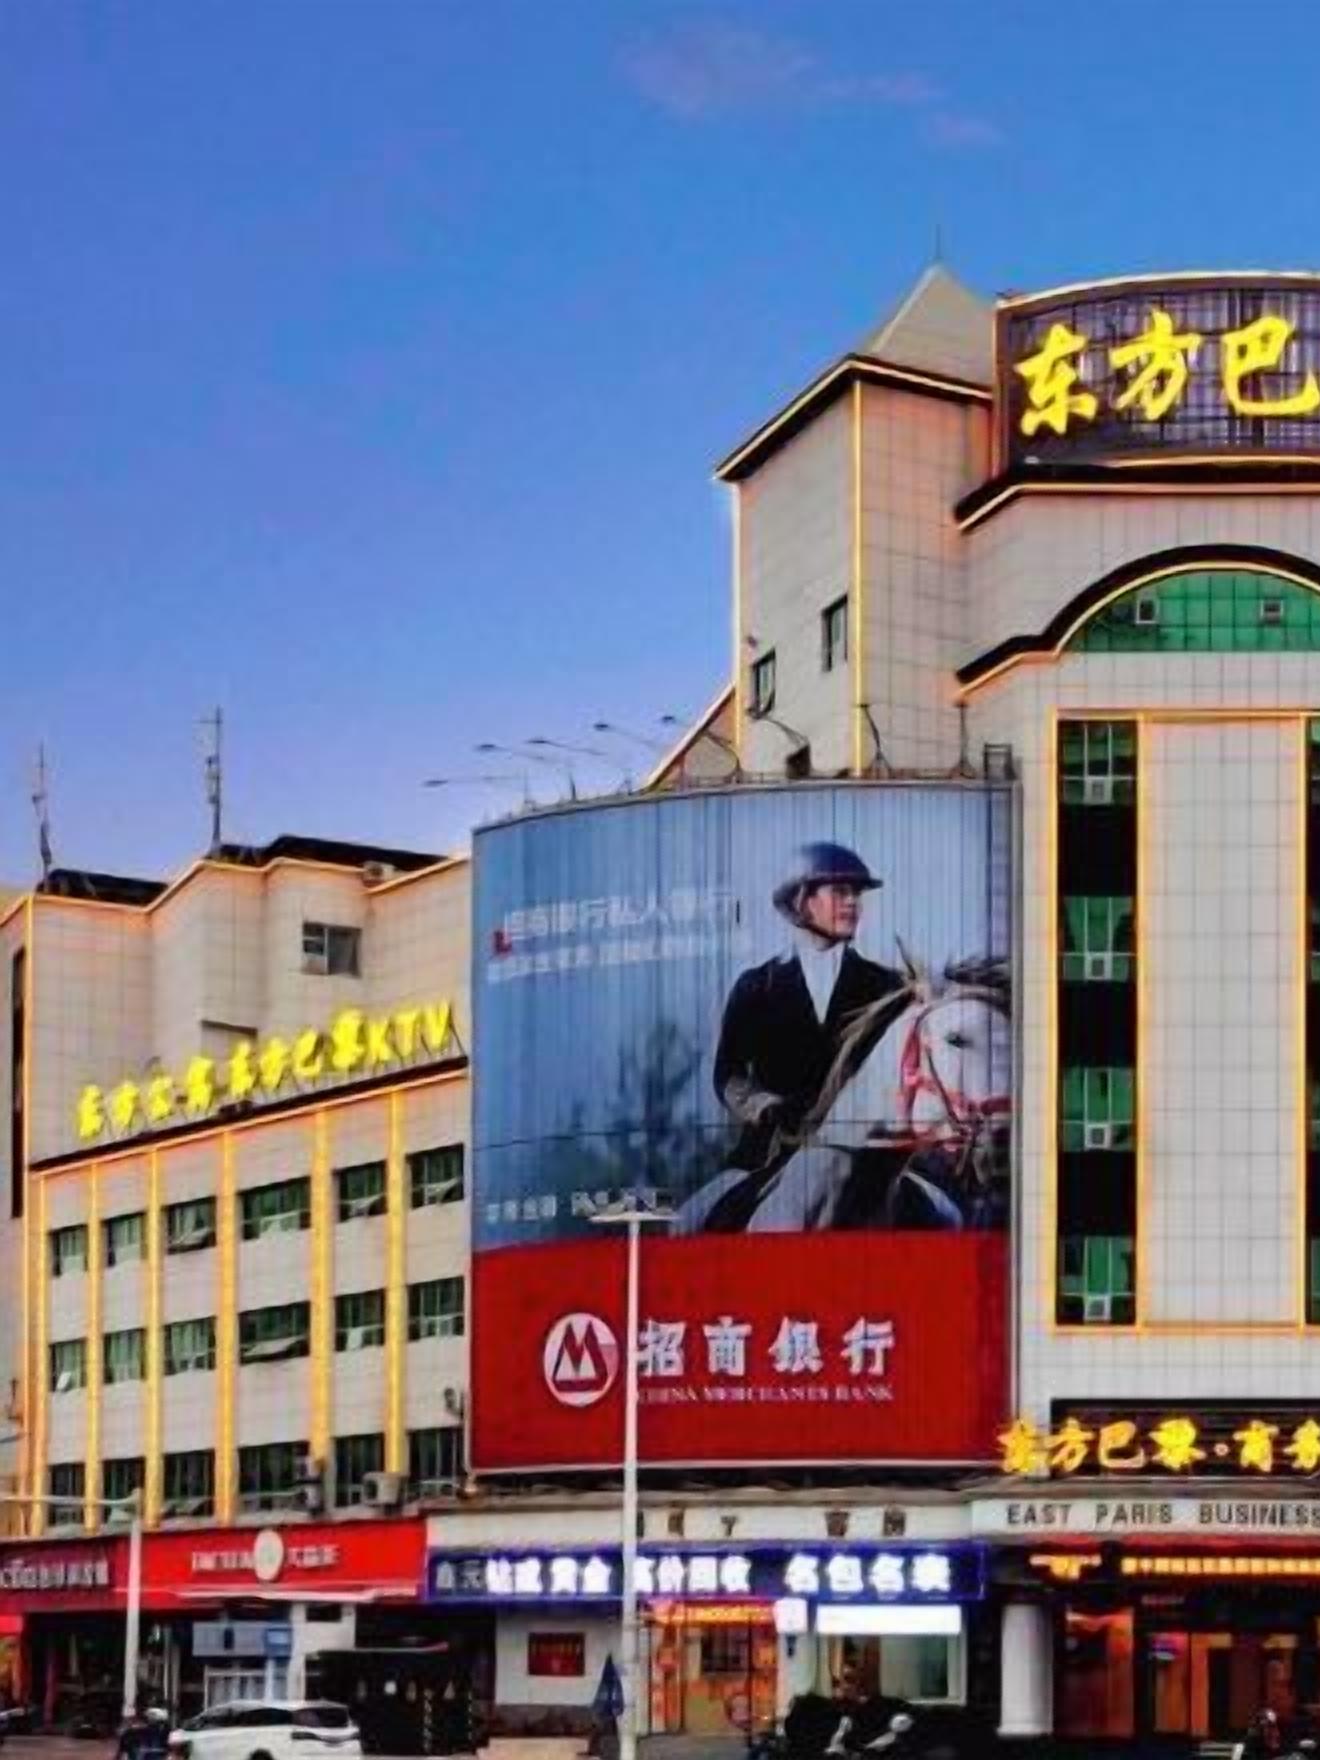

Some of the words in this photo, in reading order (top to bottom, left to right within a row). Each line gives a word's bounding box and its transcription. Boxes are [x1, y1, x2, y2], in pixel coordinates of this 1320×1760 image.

[638, 1316, 895, 1377] 招商银行
[1006, 1504, 1071, 1526] EAST
[1096, 1504, 1173, 1526] PARIS
